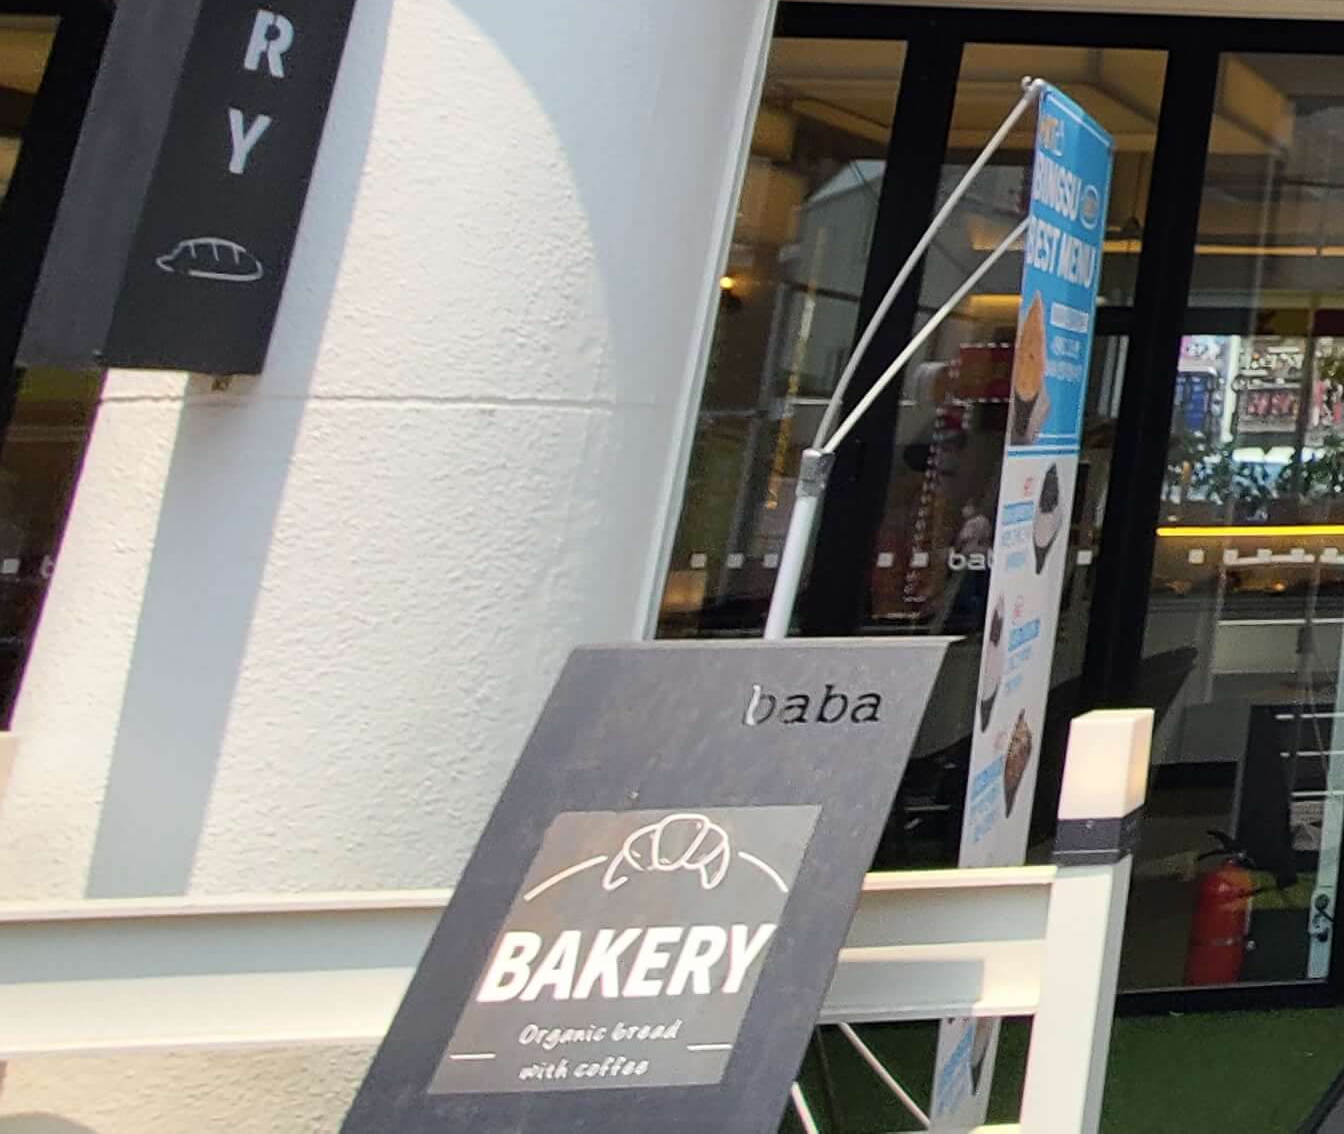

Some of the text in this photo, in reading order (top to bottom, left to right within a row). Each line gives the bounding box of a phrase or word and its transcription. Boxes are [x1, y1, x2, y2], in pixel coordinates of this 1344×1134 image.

[741, 683, 883, 726] baba
[476, 923, 779, 1004] BAKERY
[518, 1019, 681, 1049] Organic bread
[519, 1055, 650, 1081] with coffee
